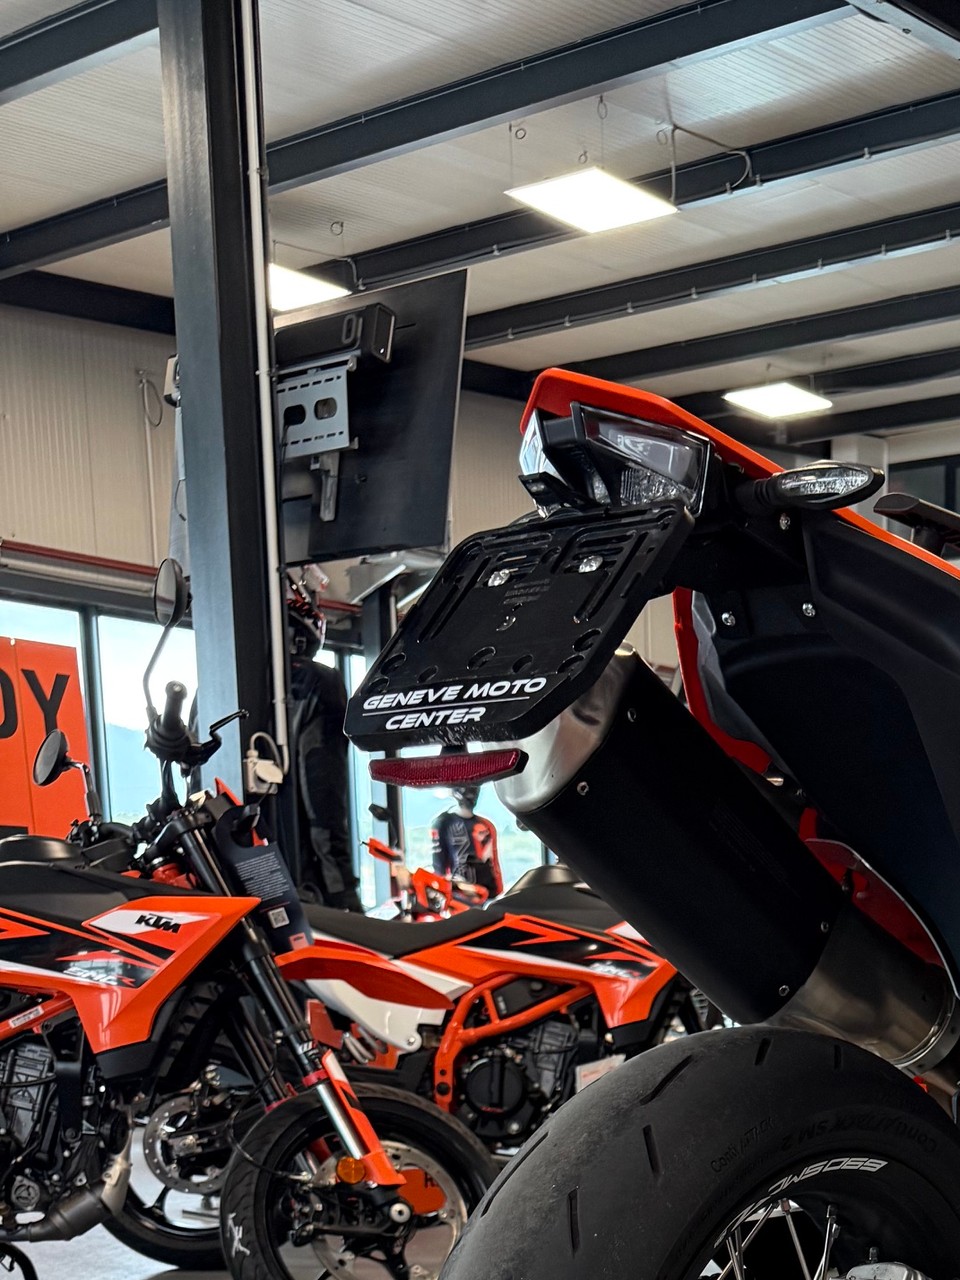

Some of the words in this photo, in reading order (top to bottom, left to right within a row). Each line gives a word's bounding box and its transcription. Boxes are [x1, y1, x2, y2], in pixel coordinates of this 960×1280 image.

[363, 685, 463, 710] GENEVE
[463, 677, 547, 699] MOTO
[385, 707, 486, 730] CENTER
[135, 913, 182, 933] KTM
